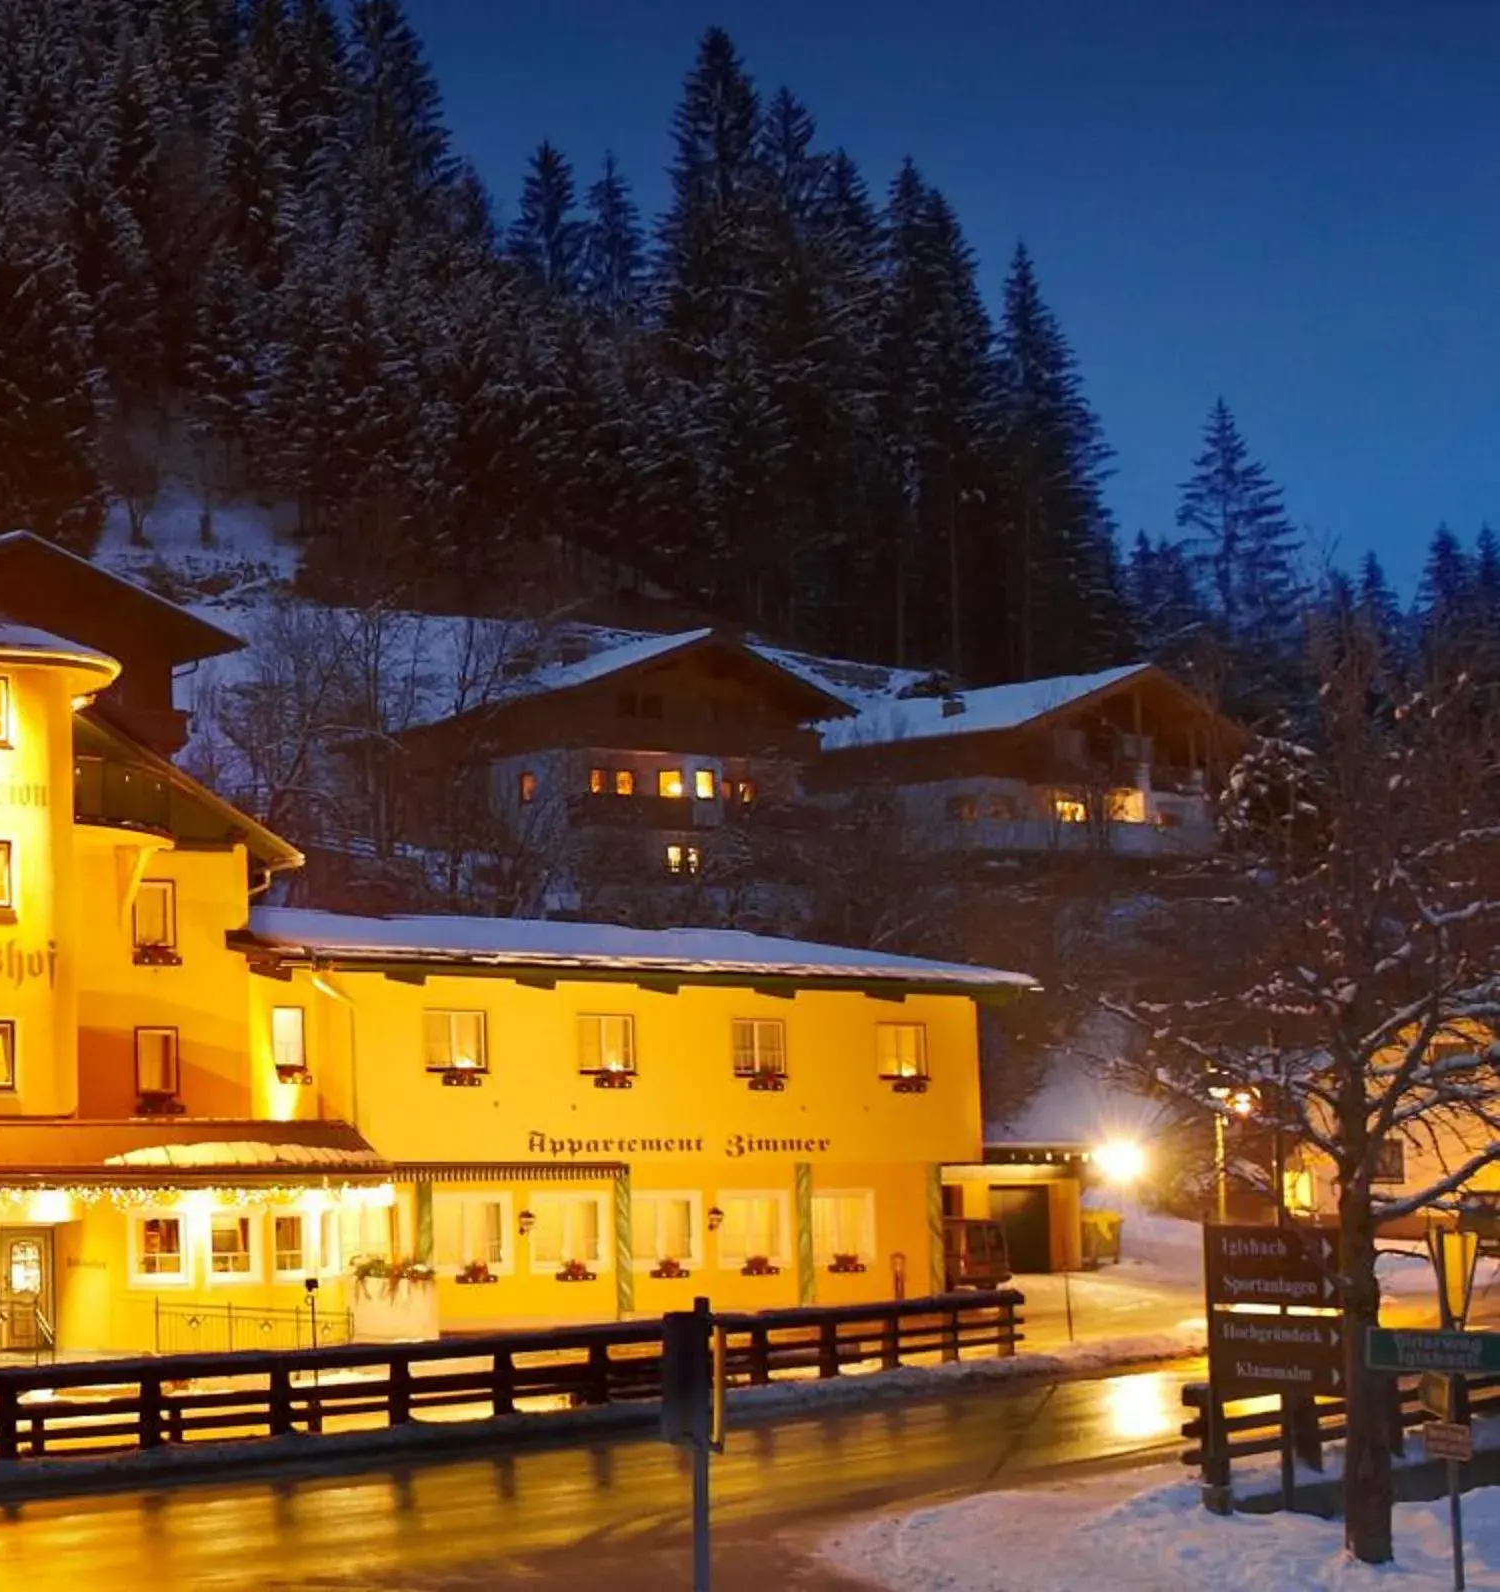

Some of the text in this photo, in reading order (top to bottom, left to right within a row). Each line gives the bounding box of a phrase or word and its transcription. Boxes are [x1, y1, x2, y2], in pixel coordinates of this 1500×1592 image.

[527, 1130, 831, 1158] Appartement Zimmer
[1222, 1276, 1318, 1298] Sportanlagen
[1222, 1323, 1323, 1344] Hochgründeck
